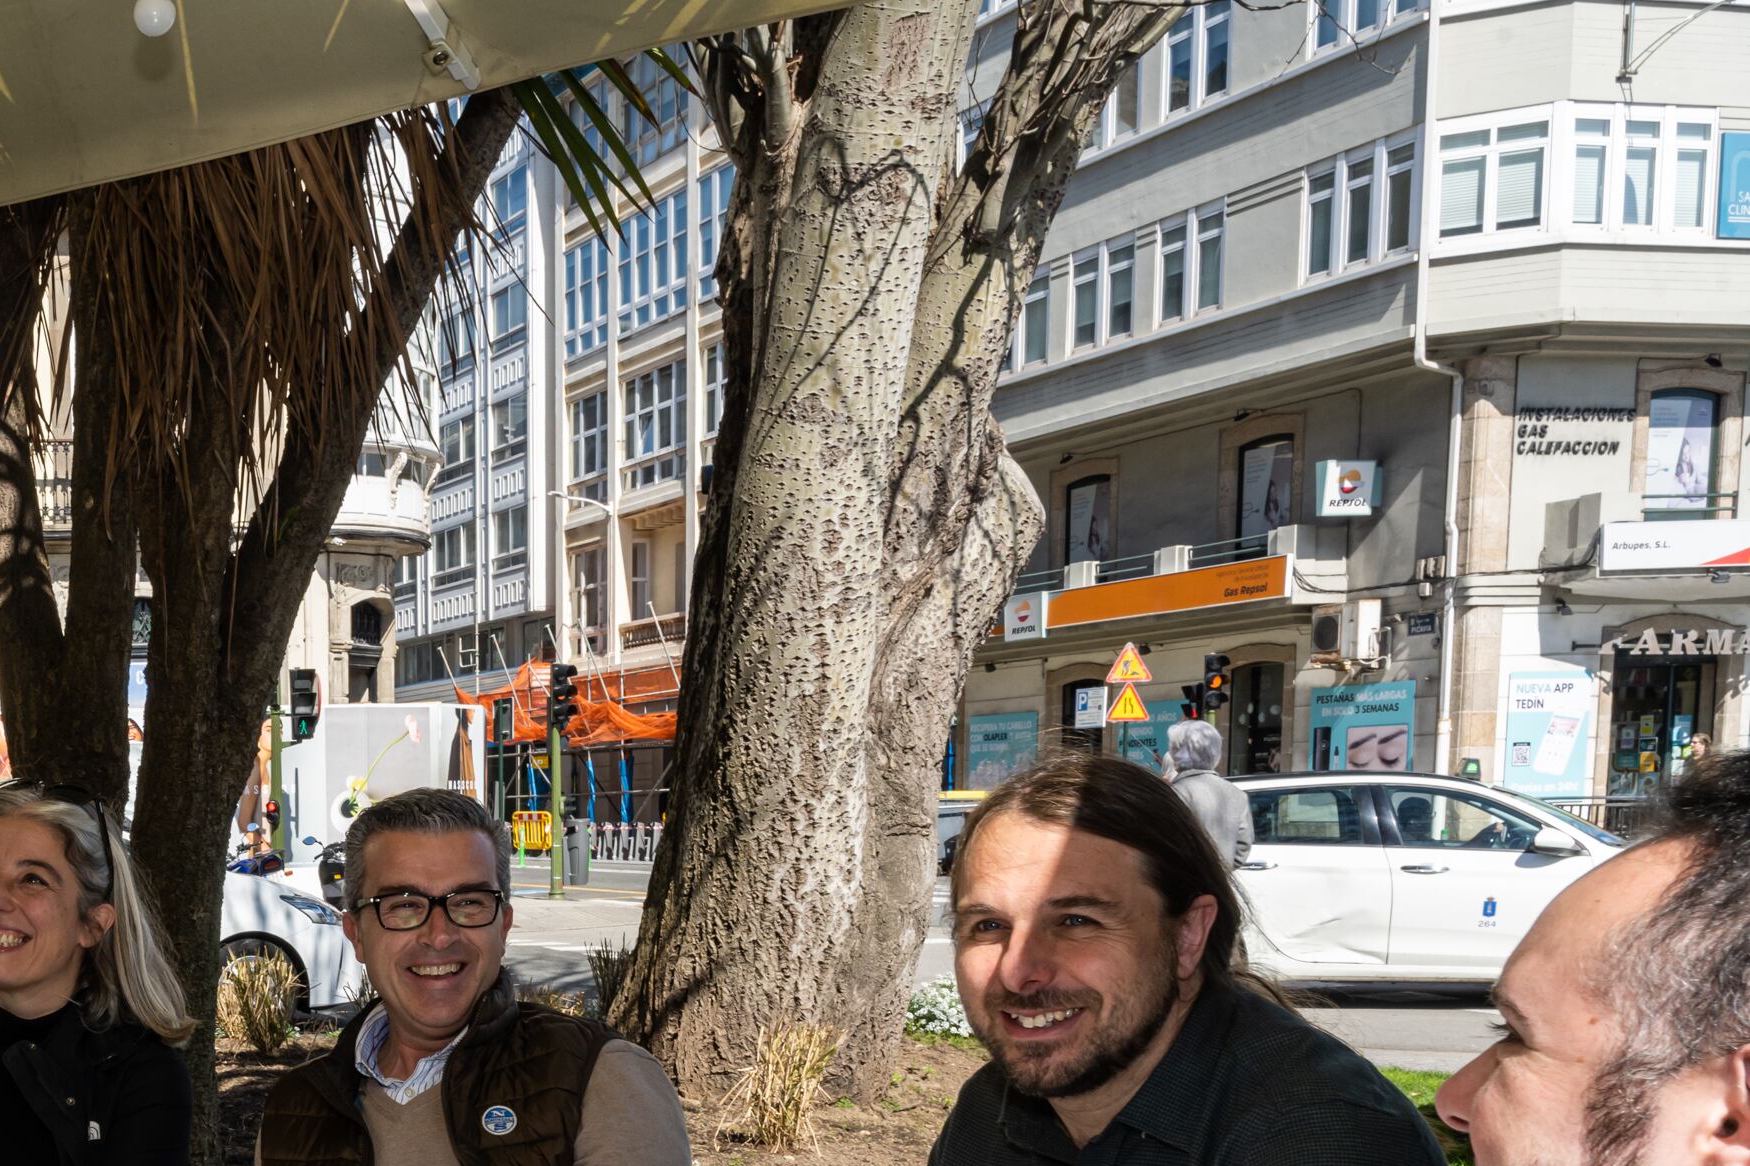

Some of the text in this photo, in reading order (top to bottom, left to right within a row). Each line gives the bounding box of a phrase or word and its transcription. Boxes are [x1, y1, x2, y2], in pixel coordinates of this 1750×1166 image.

[1518, 407, 1636, 422] INSTALACIONES
[1517, 424, 1548, 439] GAS
[1516, 441, 1619, 456] CALEFACCION
[1329, 498, 1367, 507] REPSOL
[1612, 541, 1671, 551] Arbupes, S.L.
[1224, 583, 1268, 598] Gas Repsol
[1012, 625, 1036, 635] REPSOL
[1516, 683, 1574, 695] NUEVA APP
[1078, 693, 1088, 710] P
[1316, 692, 1355, 704] PESTAÑAS
[1362, 702, 1400, 714] SEMANAS
[983, 732, 1007, 741] OLAPLEX
[448, 780, 478, 790] MASSCO
